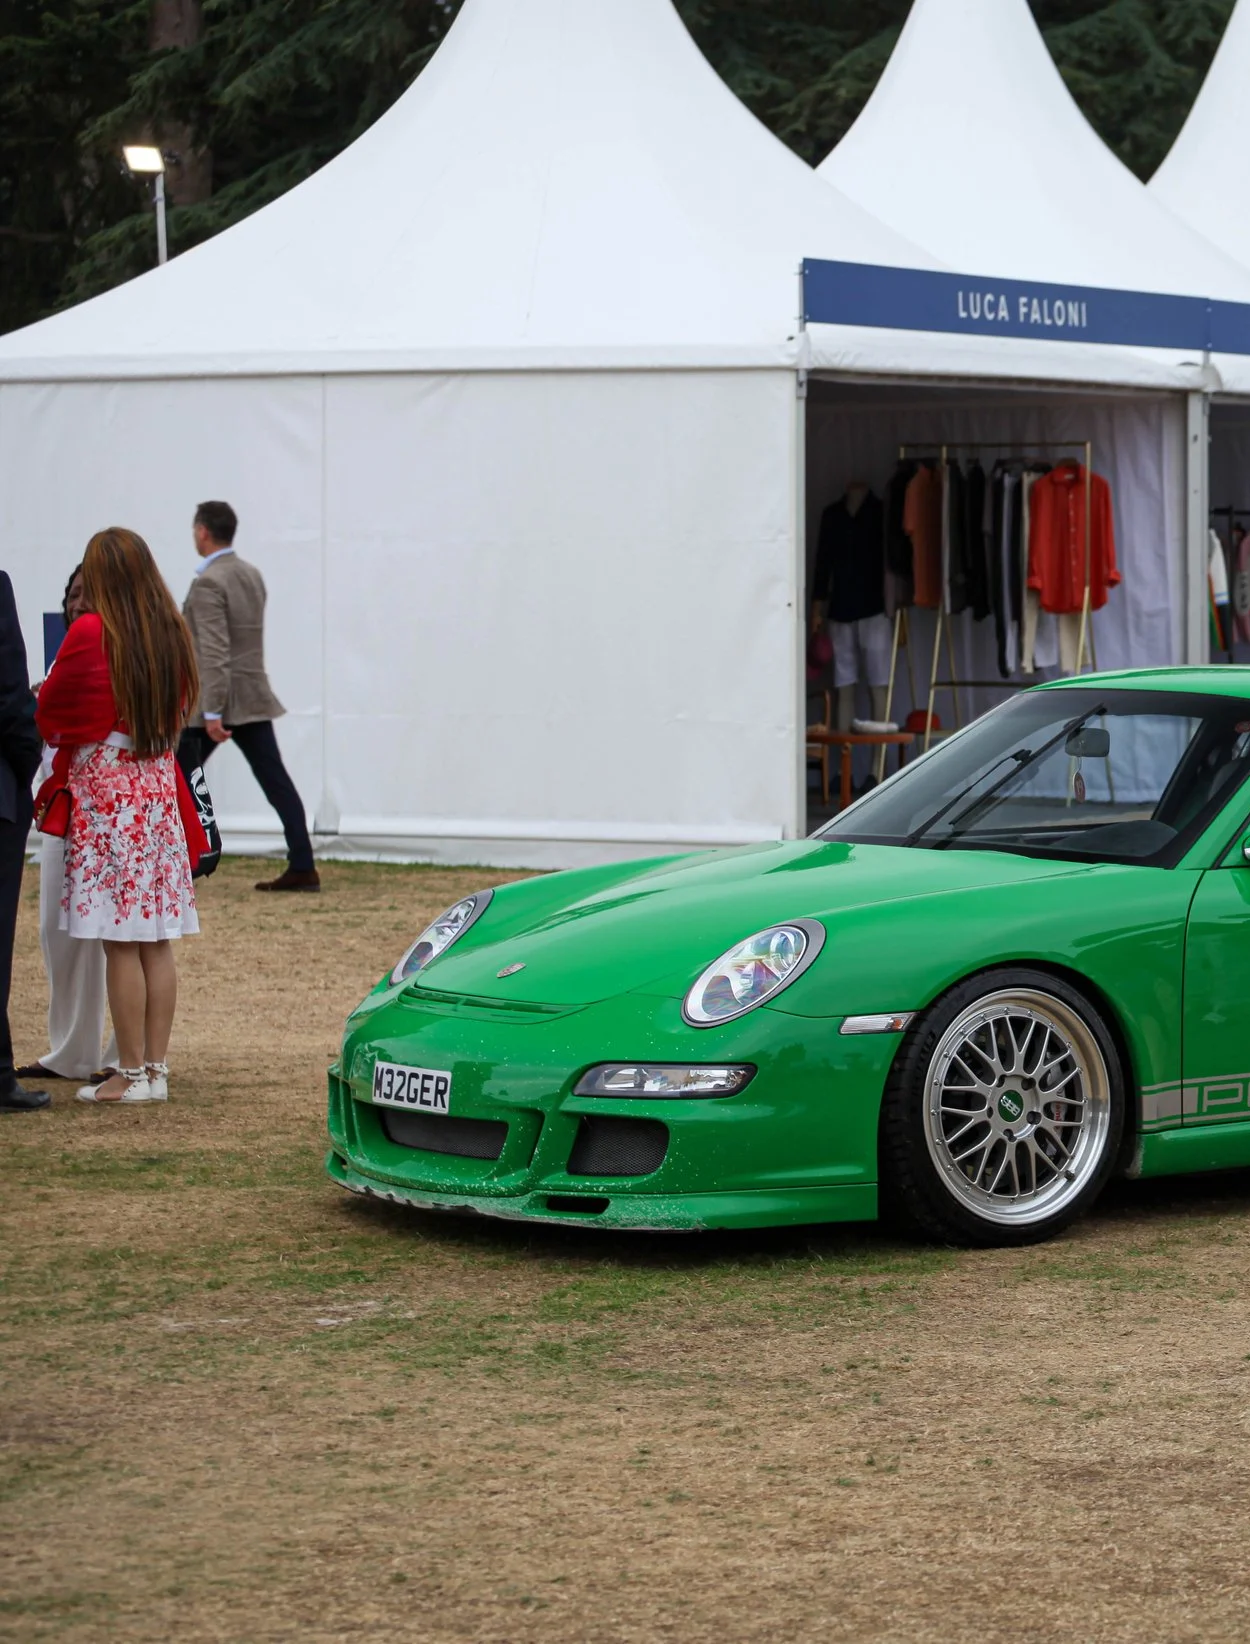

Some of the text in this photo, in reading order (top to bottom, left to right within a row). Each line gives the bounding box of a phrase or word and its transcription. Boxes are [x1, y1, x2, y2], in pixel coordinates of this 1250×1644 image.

[957, 290, 1087, 328] LUCA FALONI
[1000, 1095, 1021, 1117] BBS
